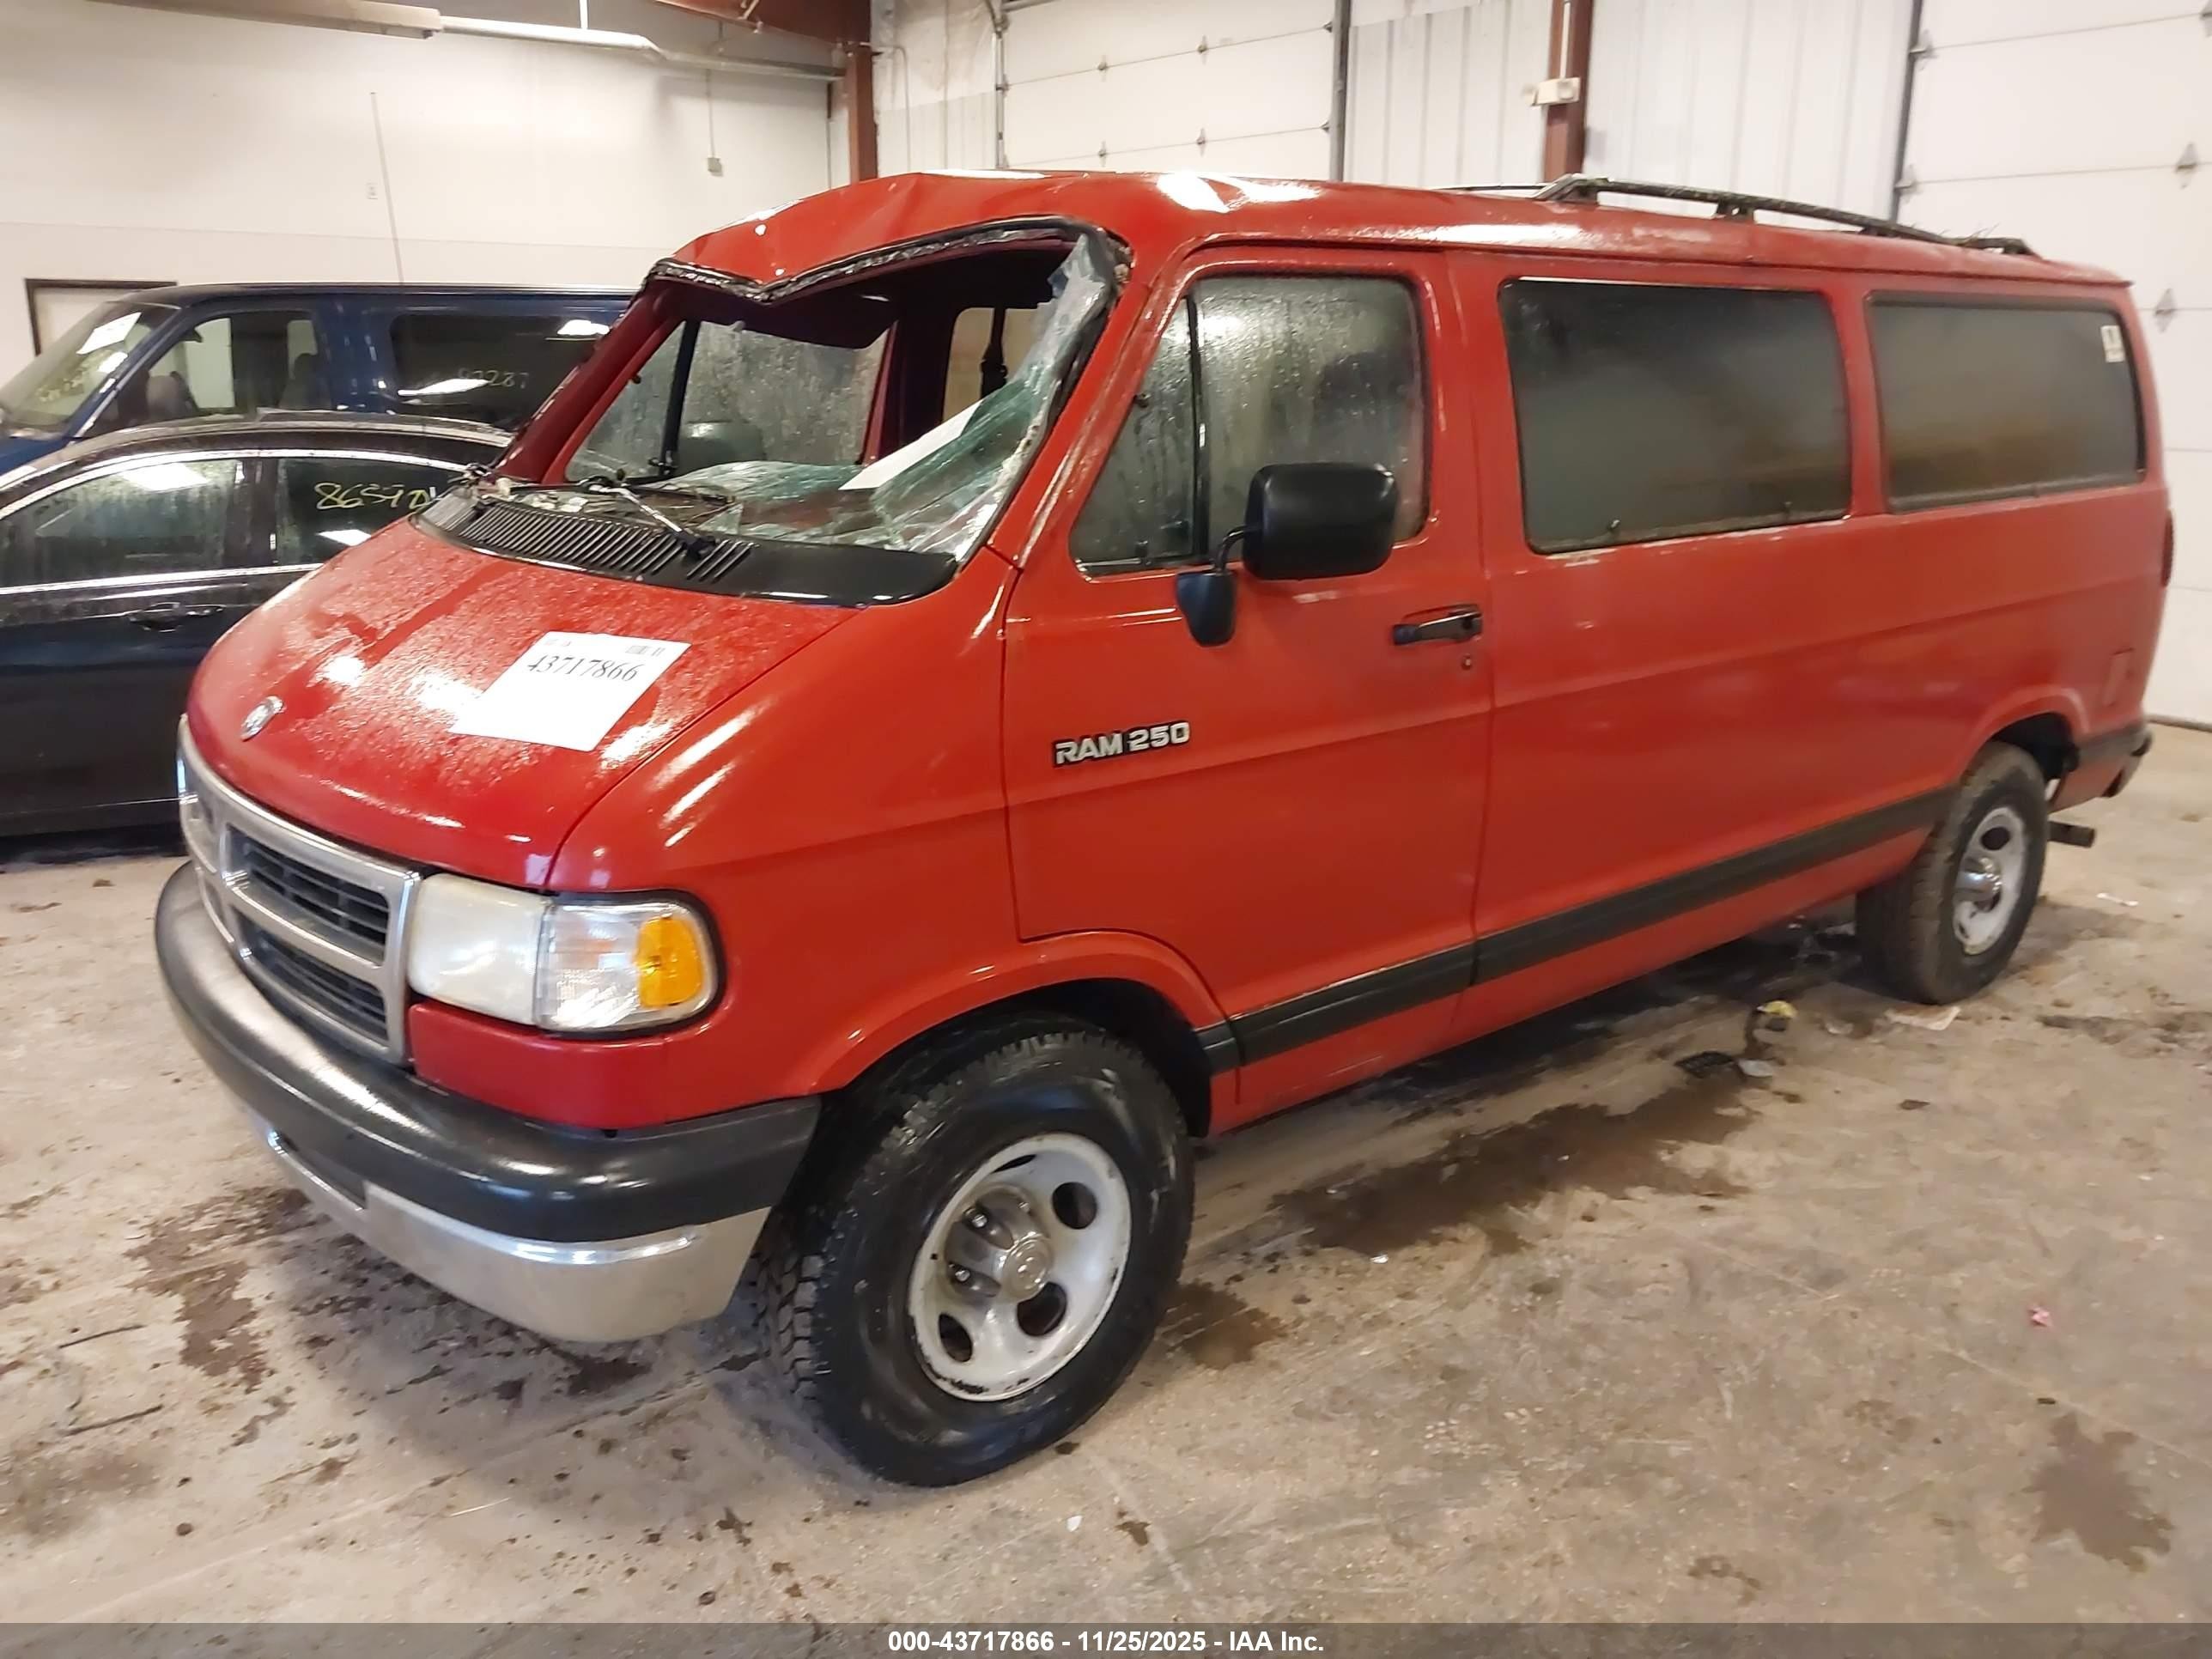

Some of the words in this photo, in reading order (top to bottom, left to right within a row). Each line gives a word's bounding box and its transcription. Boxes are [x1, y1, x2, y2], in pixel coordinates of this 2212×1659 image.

[526, 654, 645, 682] 43717866
[1054, 732, 1124, 765] RAM
[1127, 721, 1190, 752] 250
